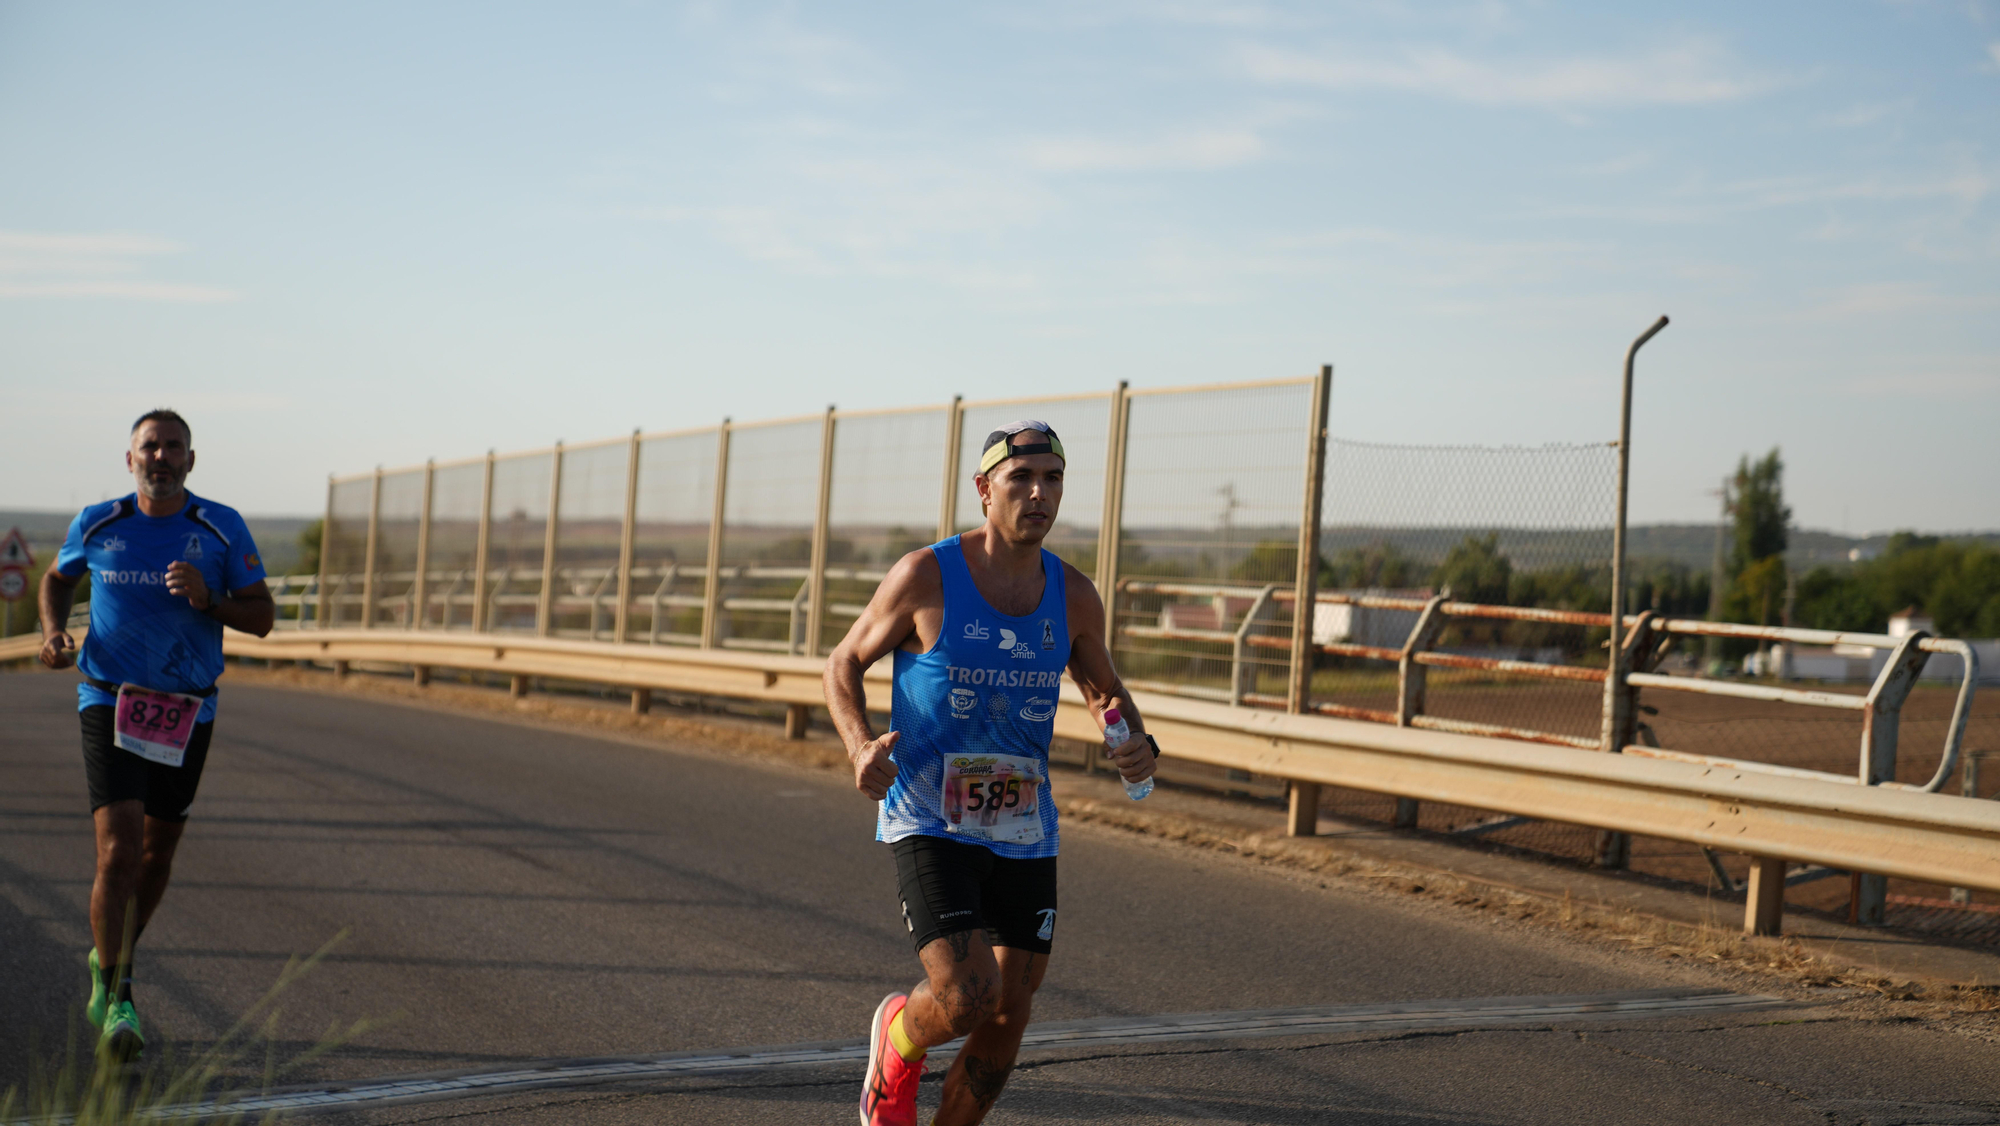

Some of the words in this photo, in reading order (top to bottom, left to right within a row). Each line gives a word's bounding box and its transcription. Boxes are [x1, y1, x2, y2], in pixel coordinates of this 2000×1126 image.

[100, 570, 164, 585] TROTASI
[1011, 650, 1036, 659] Smith
[1016, 643, 1028, 652] DS
[129, 700, 182, 731] 829
[967, 779, 1020, 812] 585
